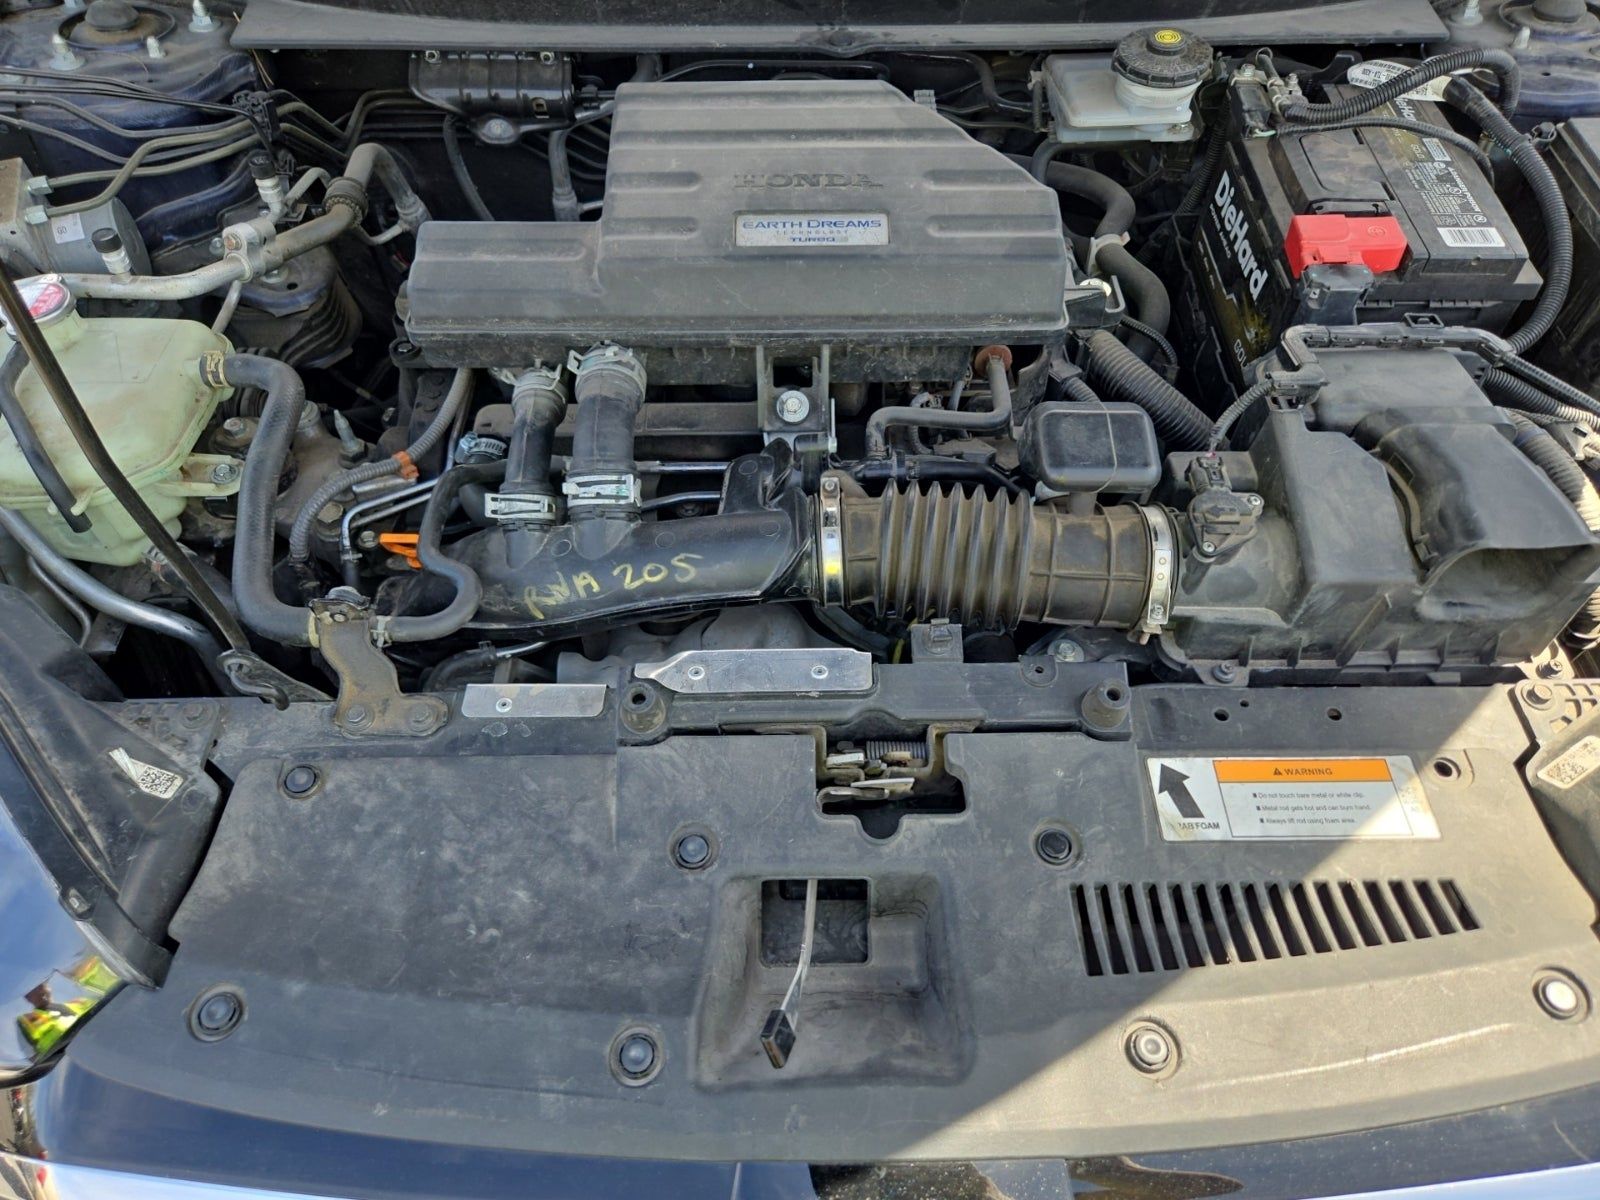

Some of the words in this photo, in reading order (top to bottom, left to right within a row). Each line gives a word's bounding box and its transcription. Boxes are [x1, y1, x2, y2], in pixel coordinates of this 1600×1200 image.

[733, 173, 884, 189] HONDA
[742, 221, 802, 229] EARTH
[807, 219, 882, 228] DREAMS
[1214, 169, 1269, 301] DieHard
[1233, 338, 1249, 368] GOL
[612, 553, 705, 590] 205
[1284, 767, 1333, 776] WARNING
[1279, 791, 1295, 799] touch
[1266, 817, 1287, 825] Always
[1307, 817, 1325, 825] using
[1325, 816, 1340, 824] foam
[1195, 822, 1220, 830] FOAM
